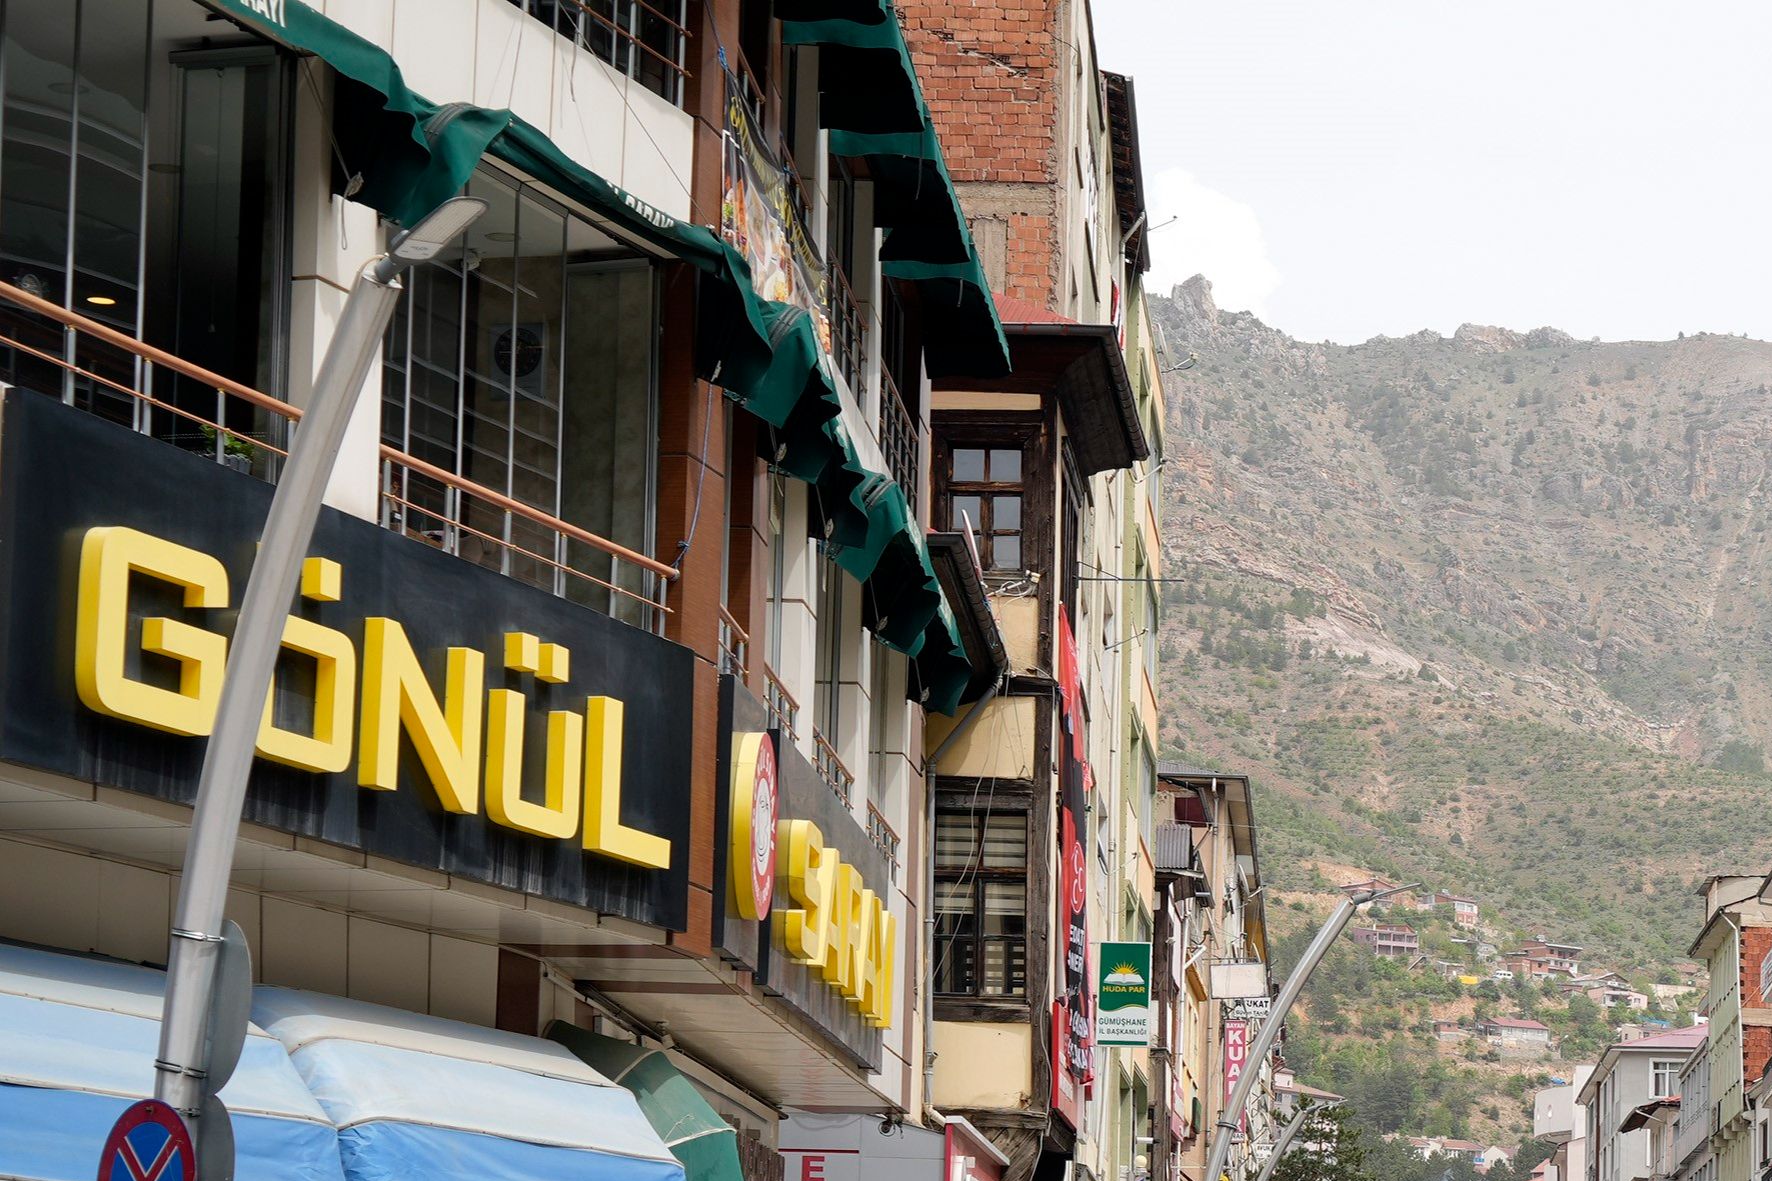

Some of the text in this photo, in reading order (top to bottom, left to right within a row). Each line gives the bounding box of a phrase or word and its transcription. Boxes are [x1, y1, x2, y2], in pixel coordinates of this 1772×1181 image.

[75, 526, 670, 870] GÖNÜL
[1098, 1018, 1147, 1027] GÜMÜŞHANE
[1107, 1028, 1147, 1037] BAŞKANLIĞI
